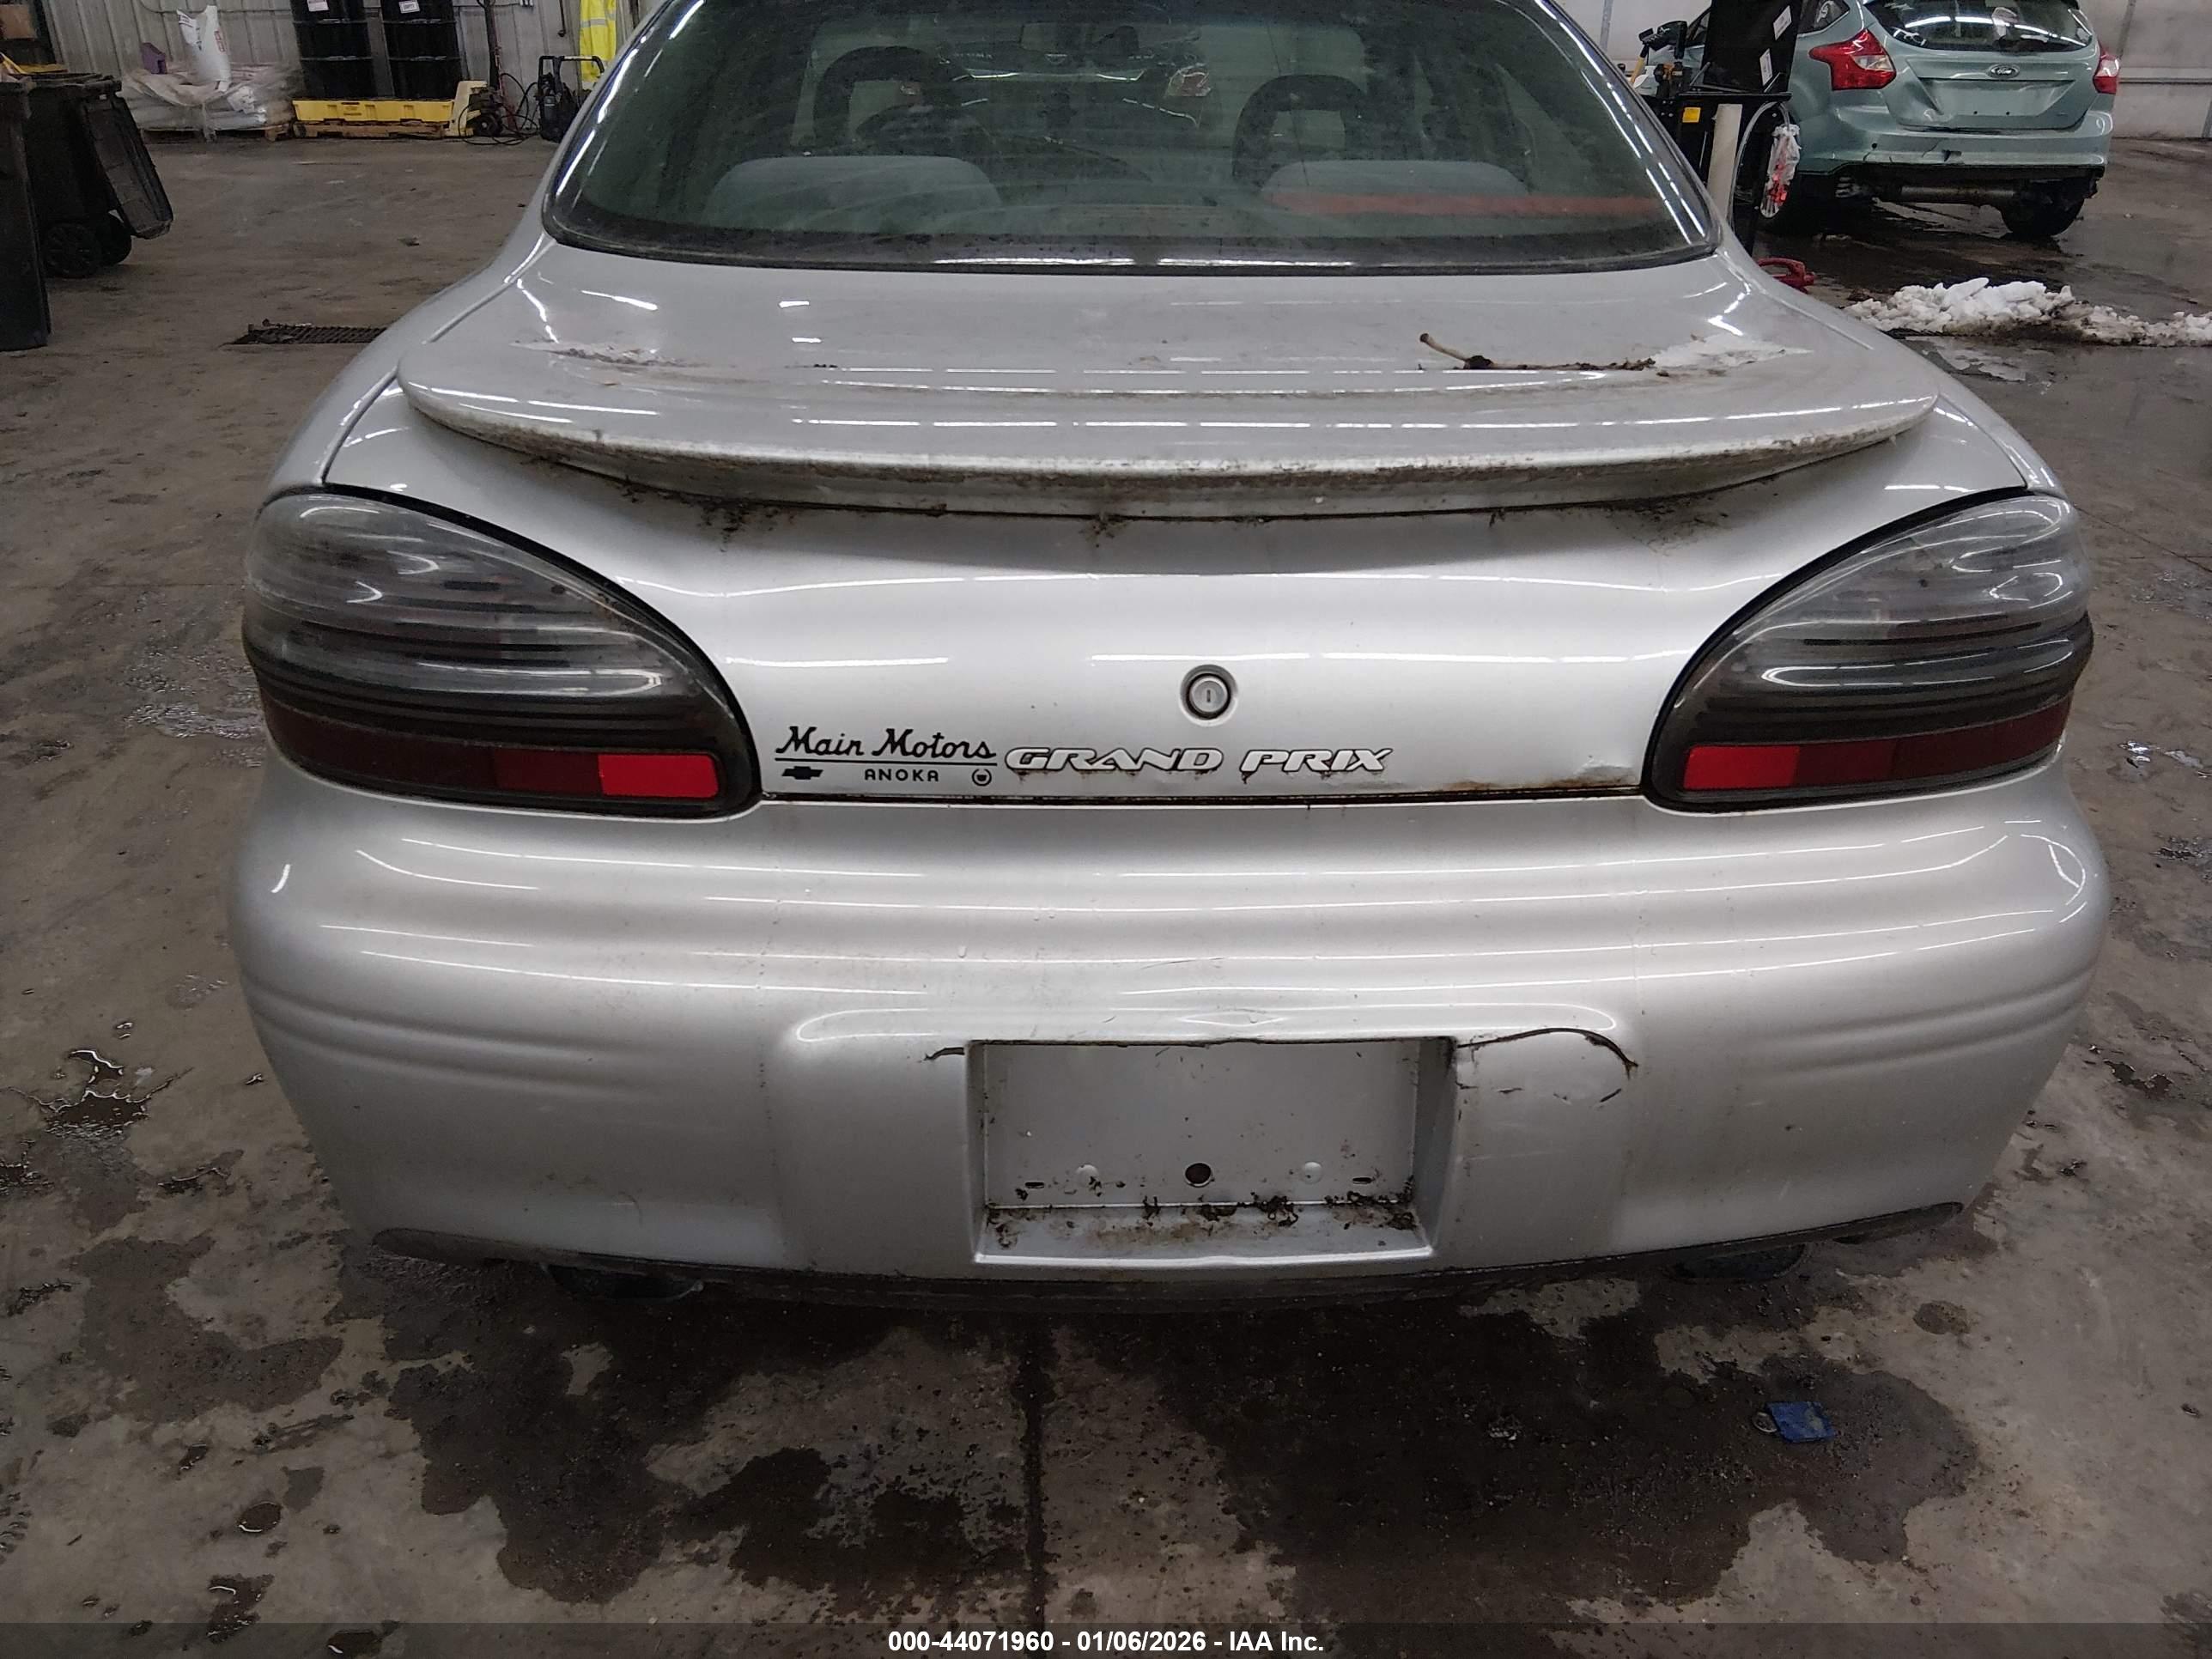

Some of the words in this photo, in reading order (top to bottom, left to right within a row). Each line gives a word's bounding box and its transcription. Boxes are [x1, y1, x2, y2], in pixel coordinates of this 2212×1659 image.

[775, 726, 865, 756] Main
[872, 728, 997, 759] Motors
[1005, 747, 1224, 772] GRAND
[1239, 748, 1394, 773] PRIX
[865, 769, 939, 782] ANOKA
